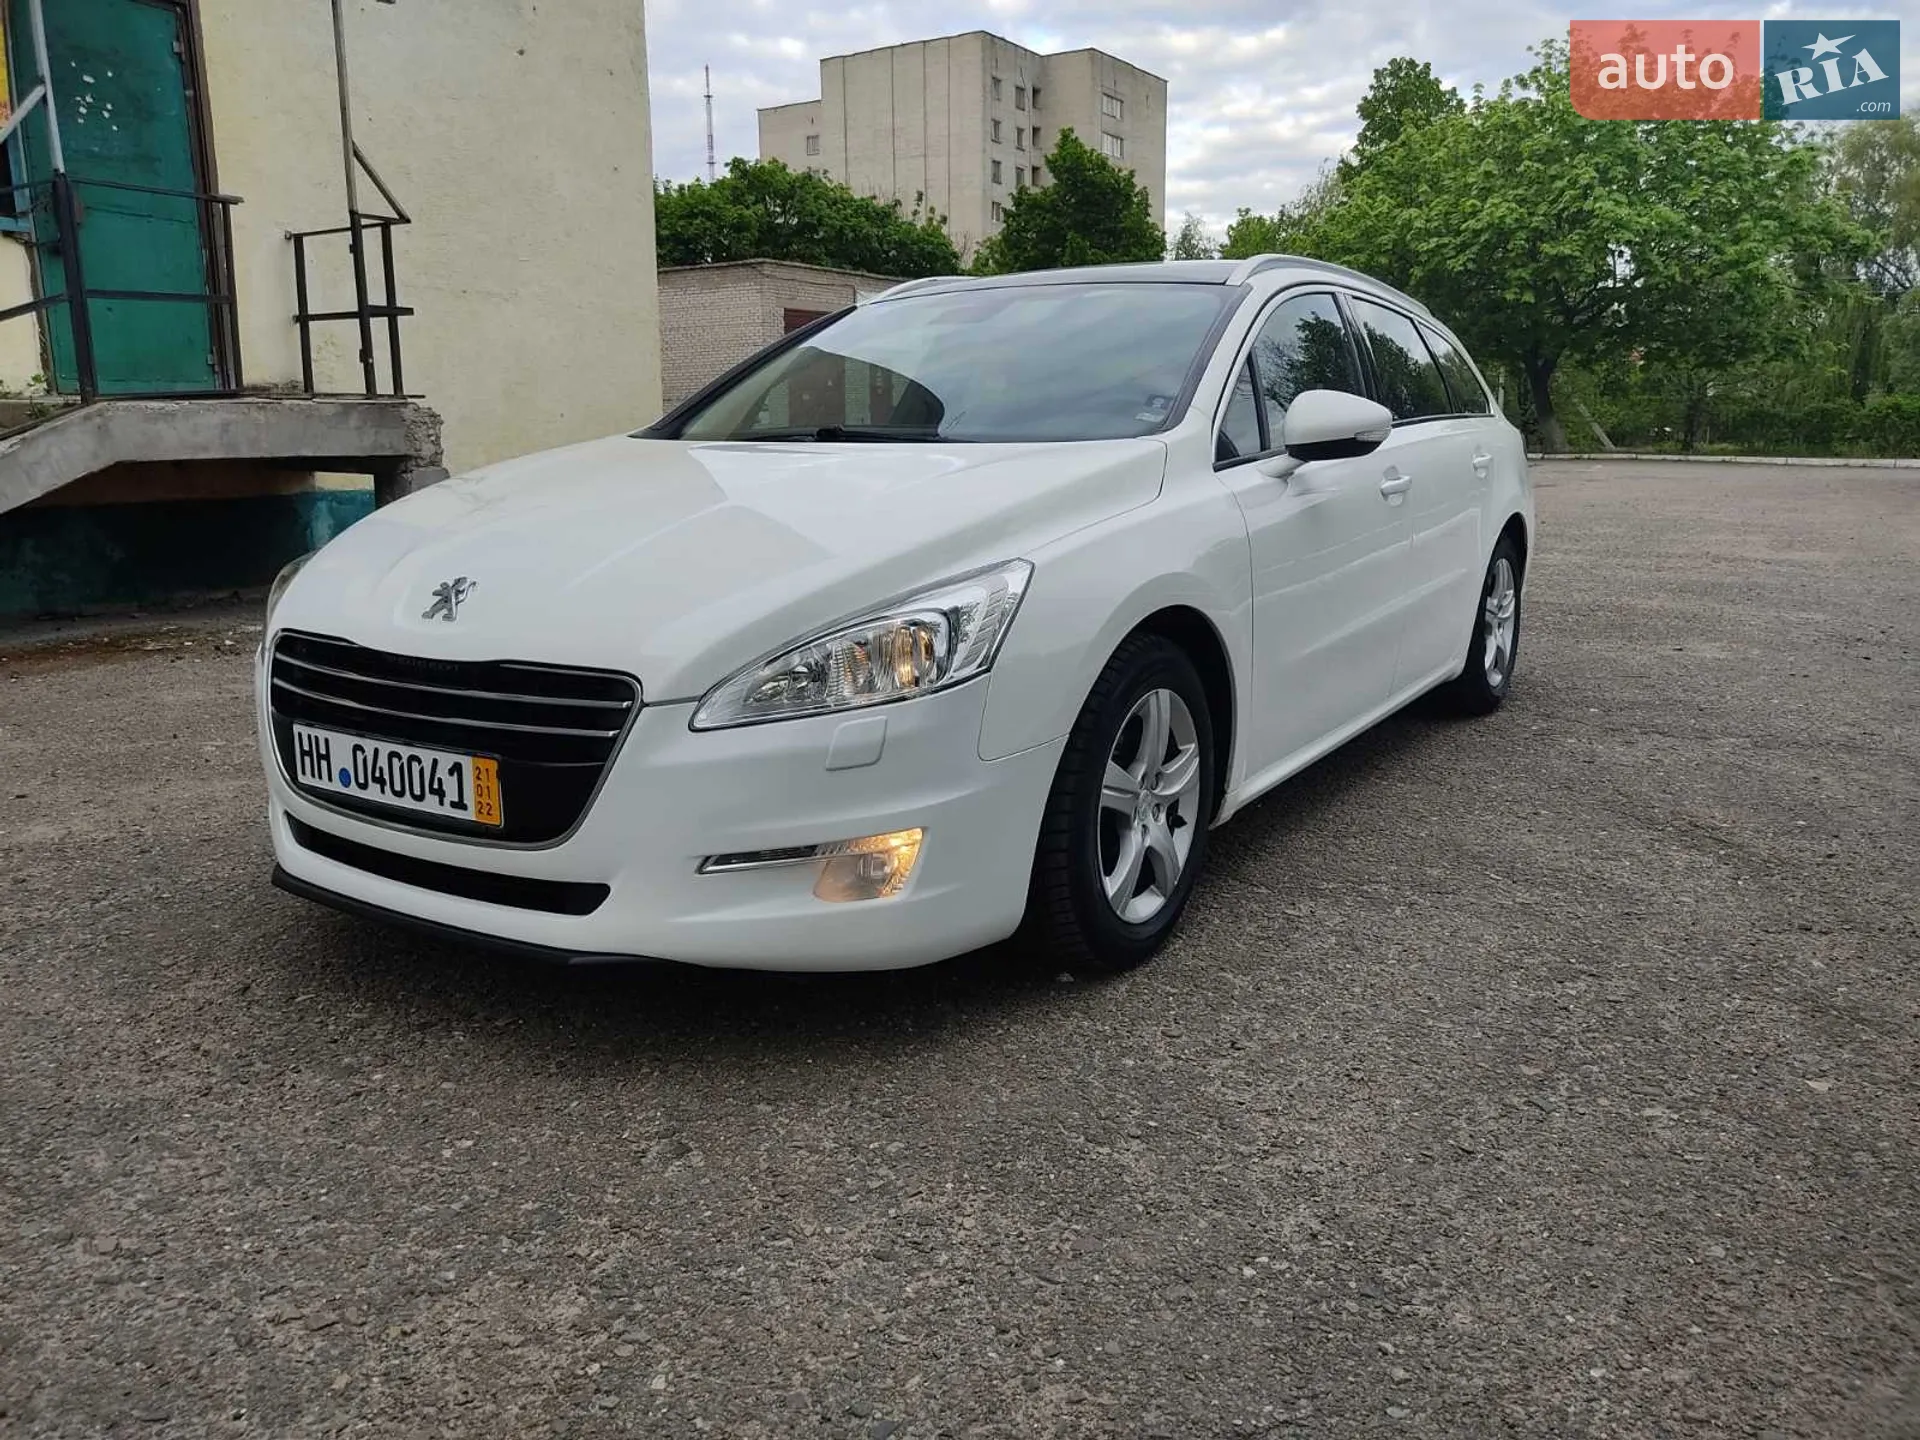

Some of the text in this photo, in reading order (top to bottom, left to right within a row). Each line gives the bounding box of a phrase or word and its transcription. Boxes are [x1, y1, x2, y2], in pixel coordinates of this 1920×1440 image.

[297, 731, 469, 812] HH 040041
[475, 765, 490, 782] 21
[476, 783, 491, 799] 01
[477, 801, 493, 817] 22
